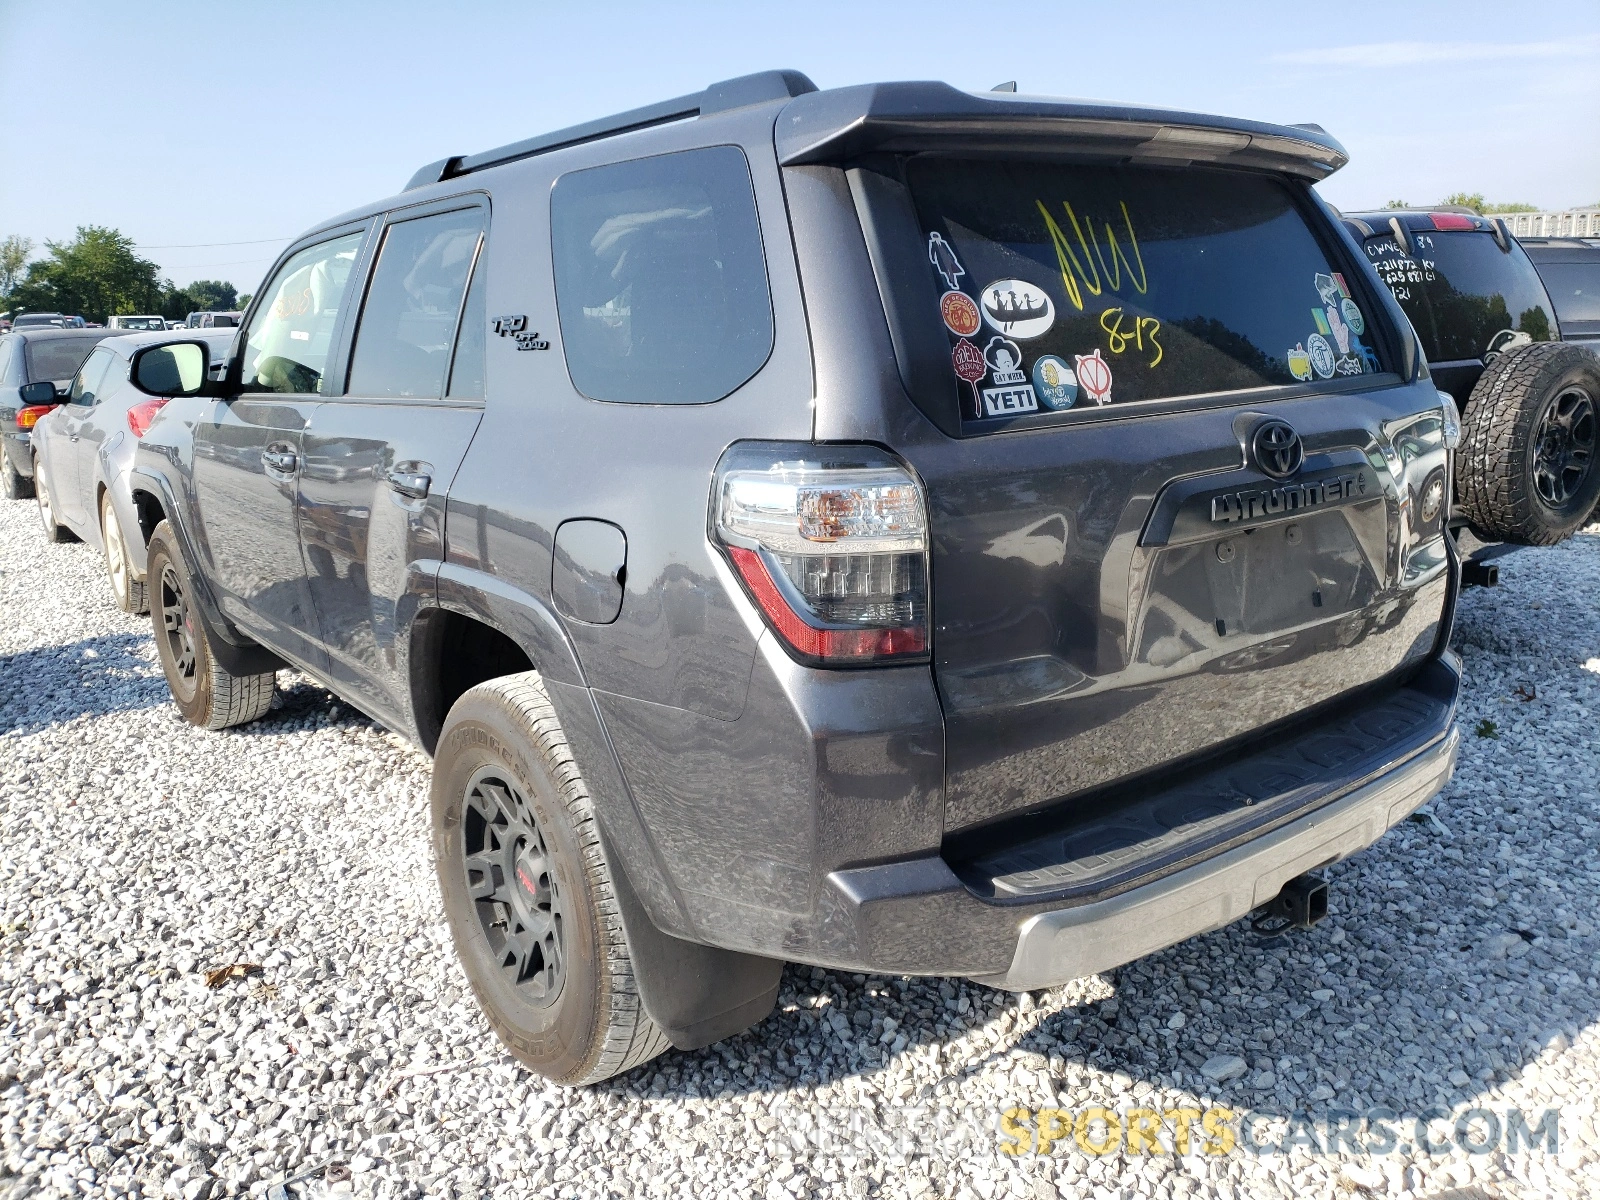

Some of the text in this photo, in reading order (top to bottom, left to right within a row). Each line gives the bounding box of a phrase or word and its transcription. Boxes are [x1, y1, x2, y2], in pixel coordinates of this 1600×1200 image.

[951, 295, 976, 316] BELGIUM
[491, 315, 528, 337] TRD
[514, 332, 539, 341] OFF
[517, 341, 550, 351] ROAD
[1100, 307, 1163, 368] 8-13
[956, 345, 981, 364] ODELL
[994, 373, 1006, 383] SAY
[987, 389, 1034, 411] YETI
[1211, 472, 1366, 523] 4RUNNER
